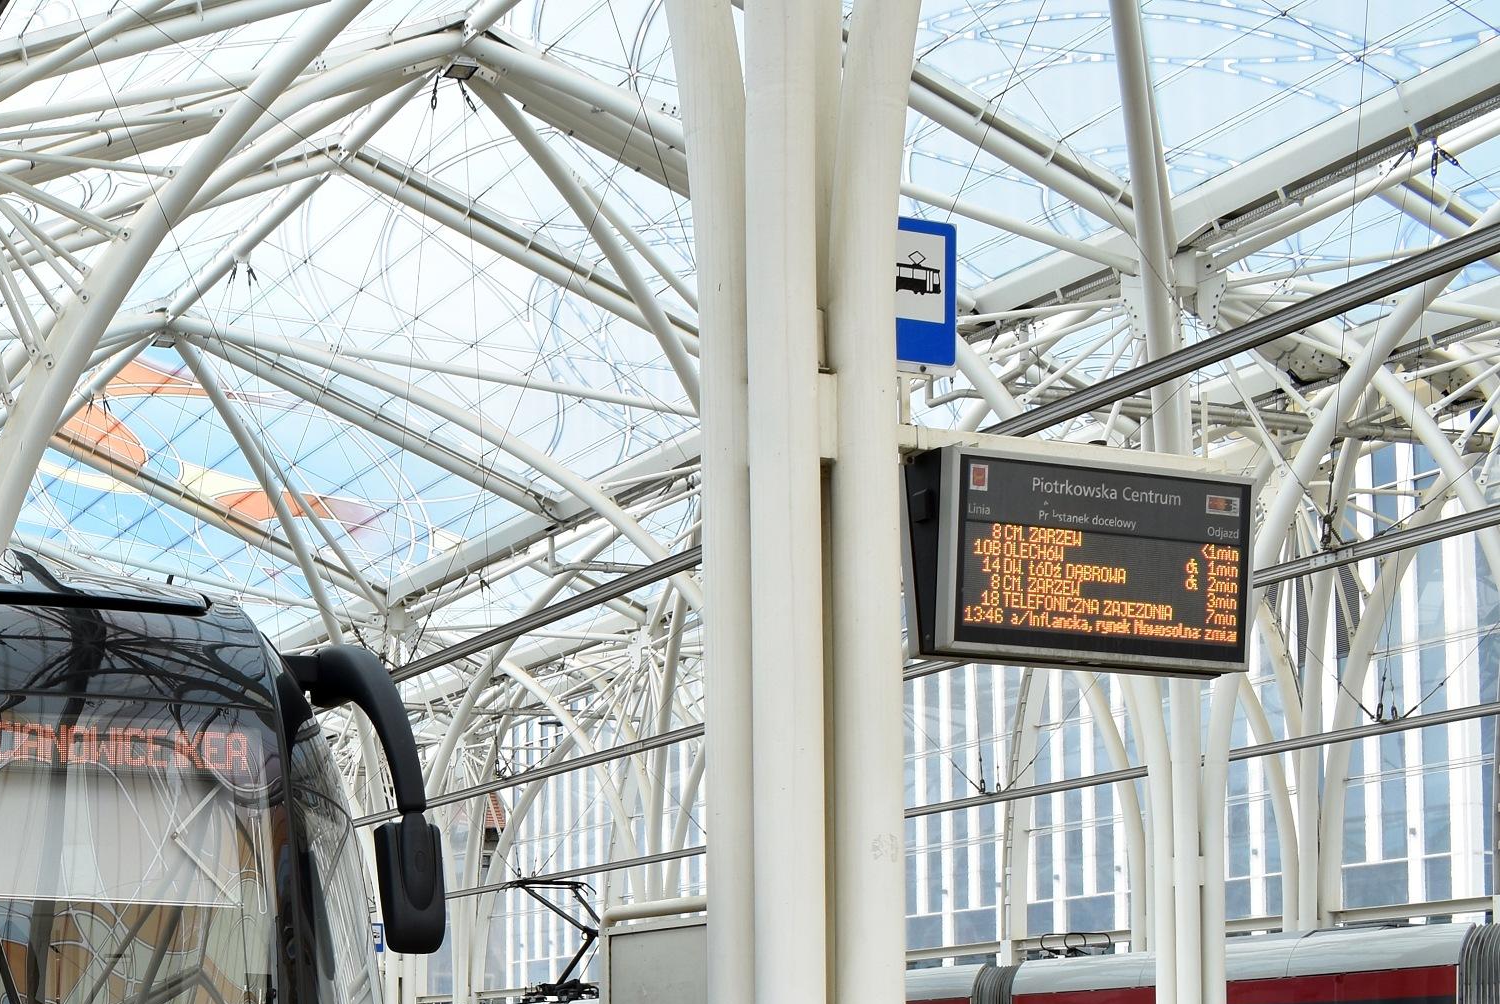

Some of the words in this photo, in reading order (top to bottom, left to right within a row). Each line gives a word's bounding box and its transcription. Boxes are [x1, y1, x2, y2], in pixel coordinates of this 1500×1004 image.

[1031, 476, 1118, 500] Piotrkowska
[1122, 486, 1181, 506] Centrum
[968, 503, 991, 515] Linia
[1038, 508, 1090, 525] Prstanek
[1091, 514, 1137, 531] docelowy
[992, 523, 1002, 540] 8
[1028, 526, 1082, 546] ZARZEW
[1207, 526, 1240, 540] Odjazd
[982, 556, 1000, 573] 14
[1207, 576, 1238, 594] 2min
[1207, 560, 1238, 577] 1min
[991, 573, 1000, 590] 8
[1027, 576, 1081, 597] ZARZEW
[1206, 592, 1237, 610] 3min
[964, 606, 1004, 624] 13:46
[981, 590, 1000, 607] 18
[1002, 591, 1100, 615] TELEFONICZNA
[1102, 600, 1173, 621] ZAJEZDNIA
[1206, 609, 1237, 626] 7min
[173, 730, 249, 772] IKEA
